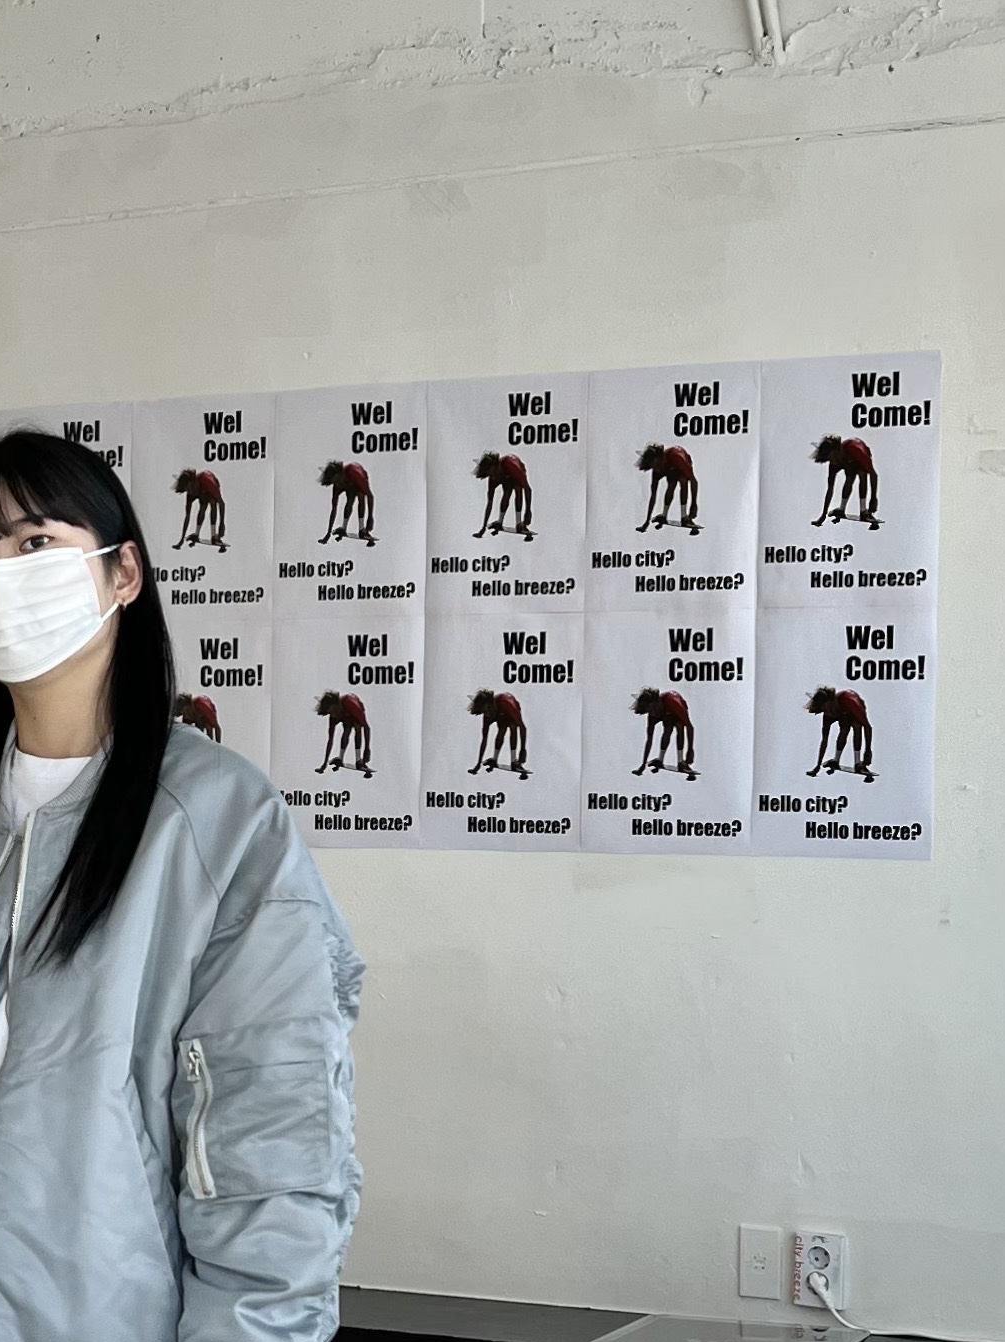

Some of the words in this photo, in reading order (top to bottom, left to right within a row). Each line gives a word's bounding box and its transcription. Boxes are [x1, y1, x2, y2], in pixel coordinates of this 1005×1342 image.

[675, 382, 719, 407] Wel
[852, 372, 899, 397] Wel
[352, 401, 392, 425] Wel
[509, 392, 550, 416] Wel
[852, 401, 930, 428] Come!
[64, 420, 100, 443] Wel
[204, 411, 241, 434] Wel
[509, 419, 578, 445] Come!
[674, 410, 748, 437] Come!
[205, 437, 266, 462] Come!
[352, 428, 418, 453] Come!
[432, 557, 468, 573] Hello
[472, 555, 510, 573] city?
[592, 552, 631, 568] Hello
[636, 550, 674, 568] city?
[765, 546, 806, 563] Hello
[811, 544, 853, 563] city?
[171, 565, 206, 582] city?
[279, 562, 314, 578] Hello
[318, 560, 353, 577] city?
[811, 571, 853, 588] Hello
[859, 569, 926, 587] breeze?
[318, 585, 354, 600] Hello
[358, 582, 415, 599] breeze?
[472, 580, 510, 596] Hello
[515, 578, 575, 595] breeze?
[636, 575, 675, 592] Hello
[679, 573, 744, 590] breeze?
[171, 590, 206, 604] Hello
[209, 587, 264, 603] breeze?
[348, 634, 387, 657] Wel
[503, 632, 546, 655] Wel
[669, 628, 713, 652] Wel
[846, 625, 894, 649] Wel
[200, 638, 238, 659] Wel
[201, 665, 262, 687] Come!
[348, 662, 414, 685] Come!
[503, 660, 573, 683] Come!
[669, 658, 743, 682] Come!
[846, 656, 925, 680] Come!
[315, 790, 350, 808] city?
[427, 792, 464, 808] Hello
[468, 792, 505, 810] city?
[588, 793, 628, 810] Hello
[632, 794, 671, 812] city?
[759, 795, 801, 812] Hello
[806, 796, 847, 814] city?
[314, 814, 351, 830] Hello
[355, 814, 413, 831] breeze?
[468, 817, 506, 833] Hello
[510, 817, 570, 834] breeze?
[632, 819, 673, 836] Hello
[679, 820, 741, 836] breeze?
[806, 822, 849, 839] Hello
[853, 822, 921, 840] breeze?
[794, 1236, 804, 1257] city
[794, 1261, 804, 1300] breeze
